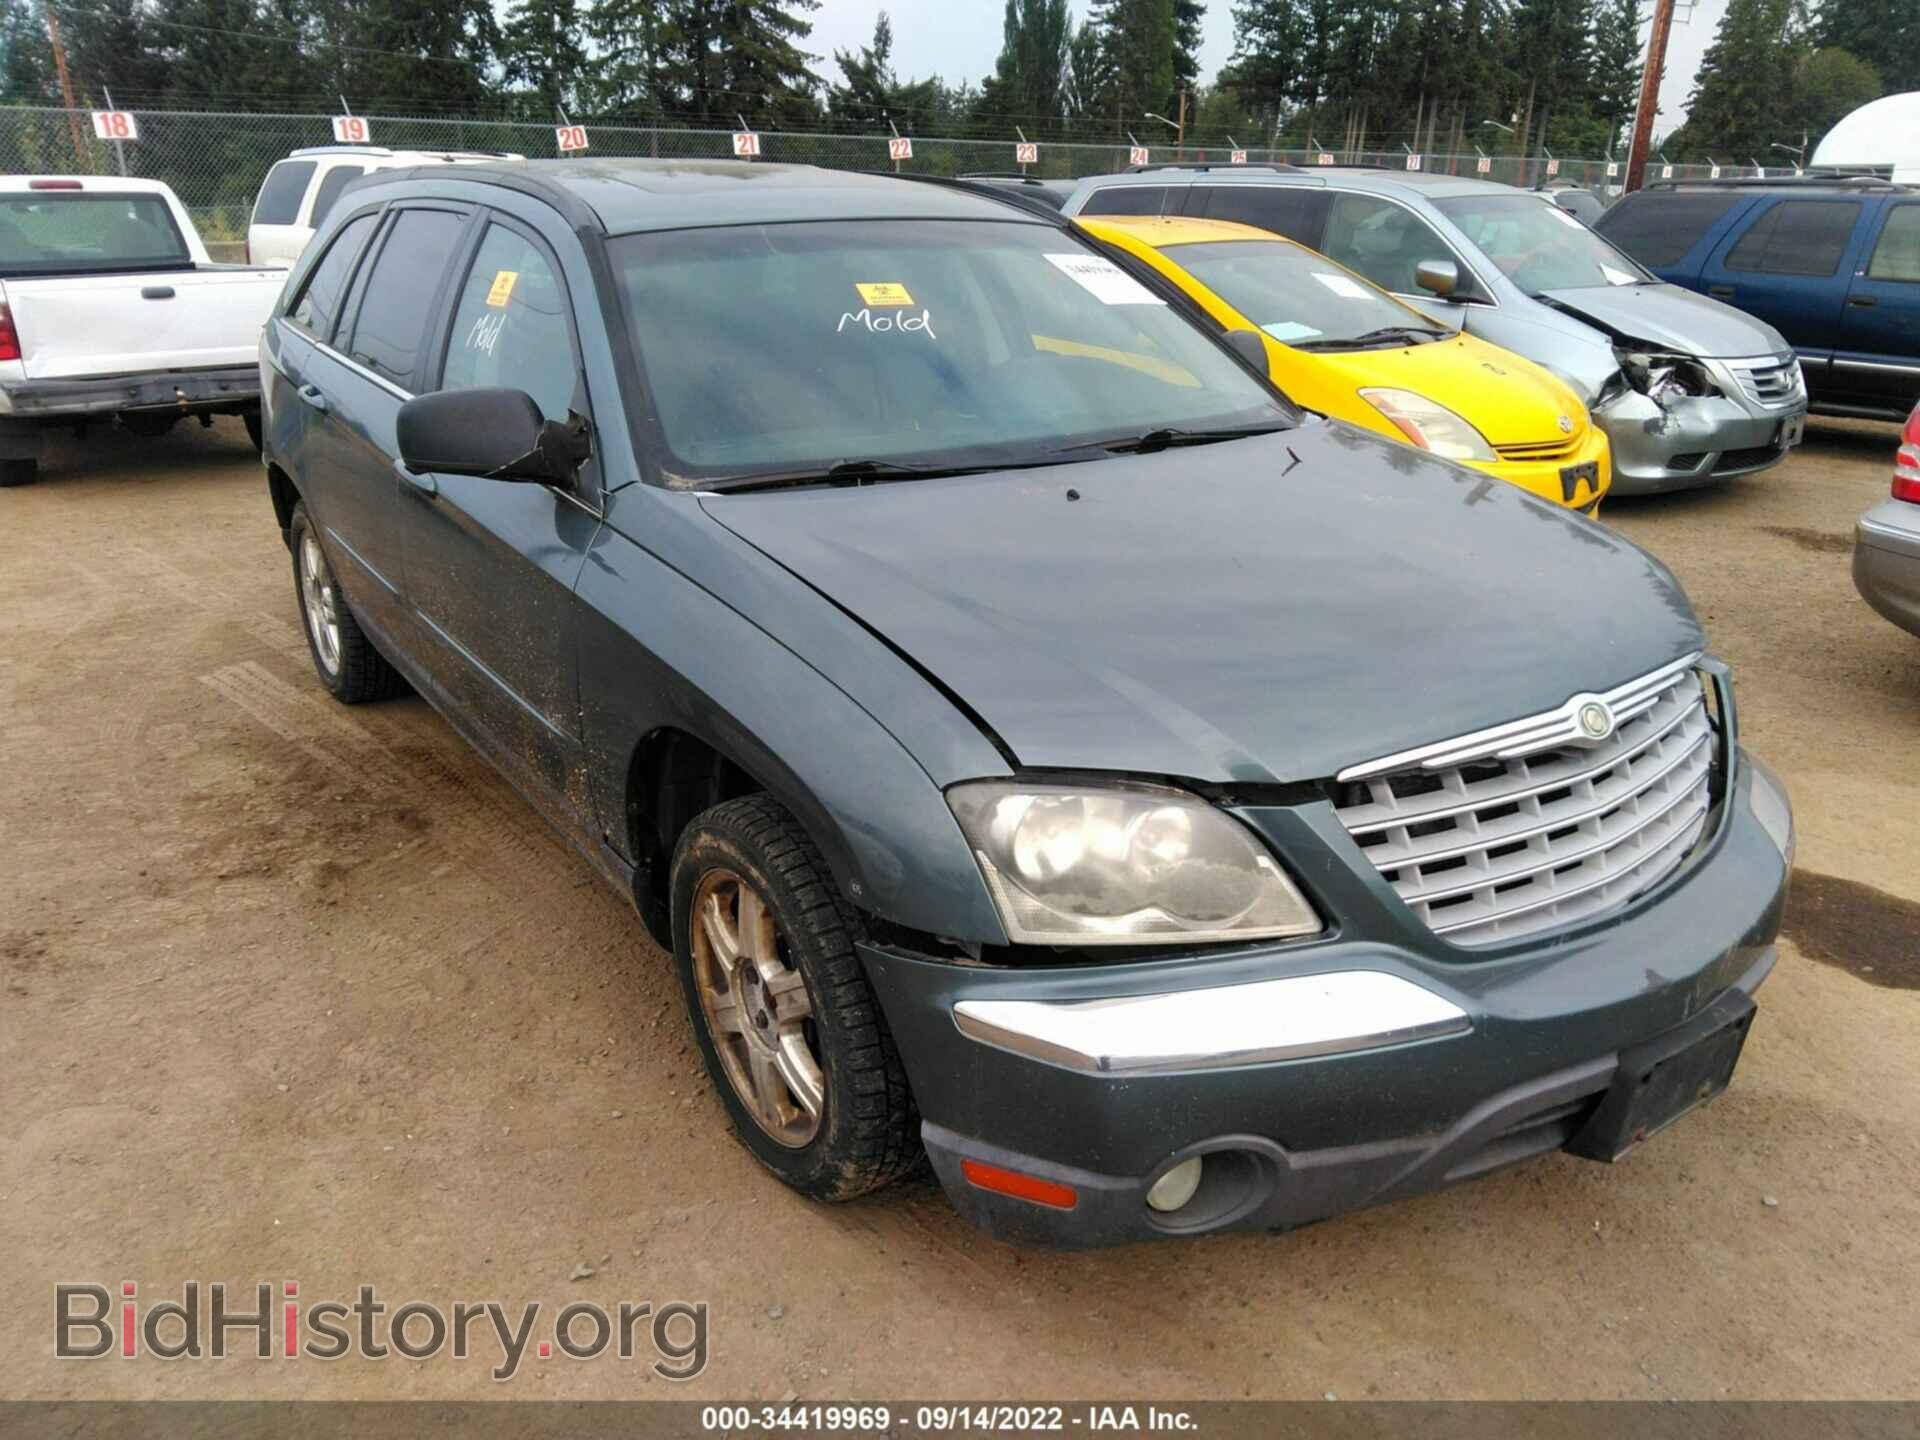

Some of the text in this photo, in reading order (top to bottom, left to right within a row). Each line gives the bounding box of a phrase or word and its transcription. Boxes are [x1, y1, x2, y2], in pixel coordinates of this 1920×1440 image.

[98, 111, 130, 137] 18
[337, 117, 364, 141] 19
[559, 126, 586, 149] 20
[736, 134, 756, 154] 21
[890, 139, 910, 158] 22
[1018, 144, 1035, 161] 23
[1131, 148, 1147, 163] 24
[837, 308, 936, 340] Mold
